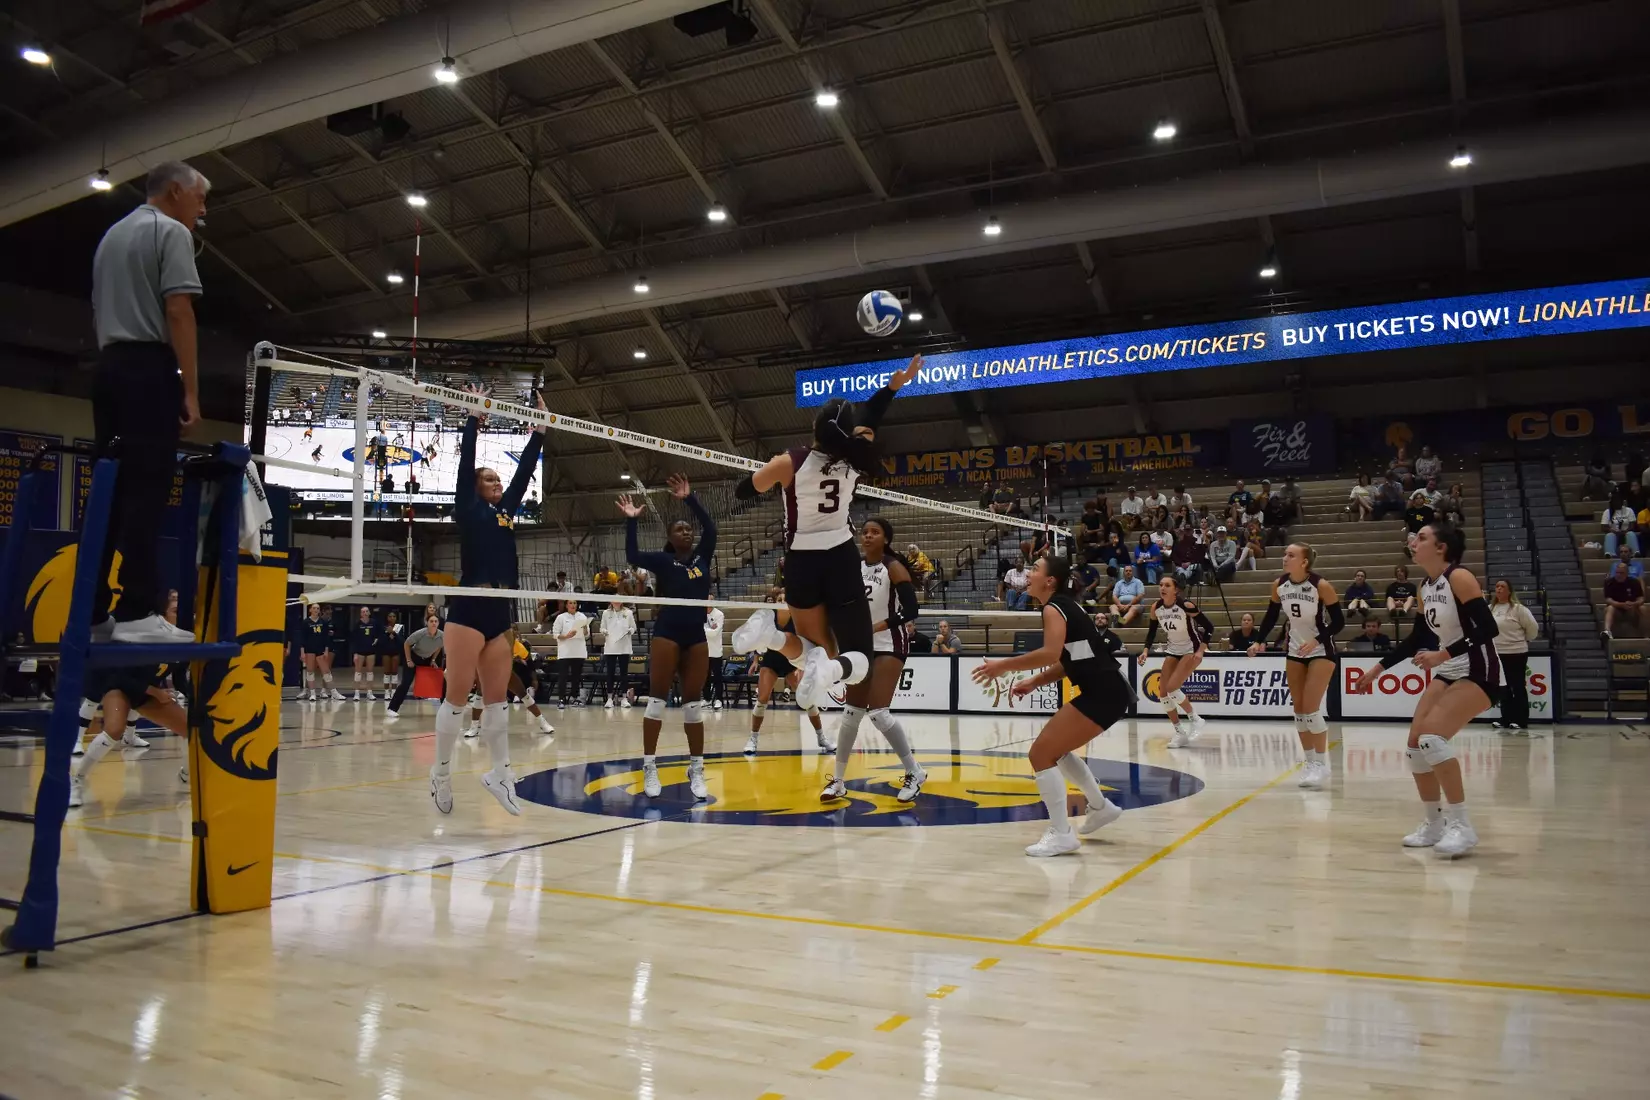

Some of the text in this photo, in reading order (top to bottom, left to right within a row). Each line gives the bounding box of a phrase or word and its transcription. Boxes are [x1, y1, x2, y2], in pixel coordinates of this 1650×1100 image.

[802, 378, 836, 397] BUY
[839, 371, 913, 393] TICKE
[917, 363, 967, 385] NOW!
[972, 331, 1266, 379] LIONATHLETICS.COM/TICKETS
[1282, 324, 1328, 347] BUY
[1333, 314, 1435, 341] TICKETS
[1442, 306, 1510, 331] NOW!
[424, 385, 442, 396] EAST
[443, 389, 465, 401] TEXAS
[496, 402, 513, 413] EAST
[513, 406, 532, 418] TEXAS
[560, 417, 574, 427] EAST
[575, 420, 592, 432] TEXAS
[1252, 420, 1307, 448] Fix &
[1507, 408, 1594, 441] GO
[907, 446, 995, 474] MEN'S
[1006, 433, 1201, 467] BASKETBALL
[1262, 442, 1312, 467] Feed
[966, 469, 992, 483] NCAA
[1107, 455, 1194, 473] ALL-AMERICANS
[818, 479, 840, 514] 3
[1291, 603, 1301, 618] 9
[1426, 608, 1440, 629] 12
[1163, 621, 1177, 631] 14
[1184, 671, 1216, 683] ilton
[1223, 670, 1288, 688] BEST PL
[1225, 688, 1244, 706] TO
